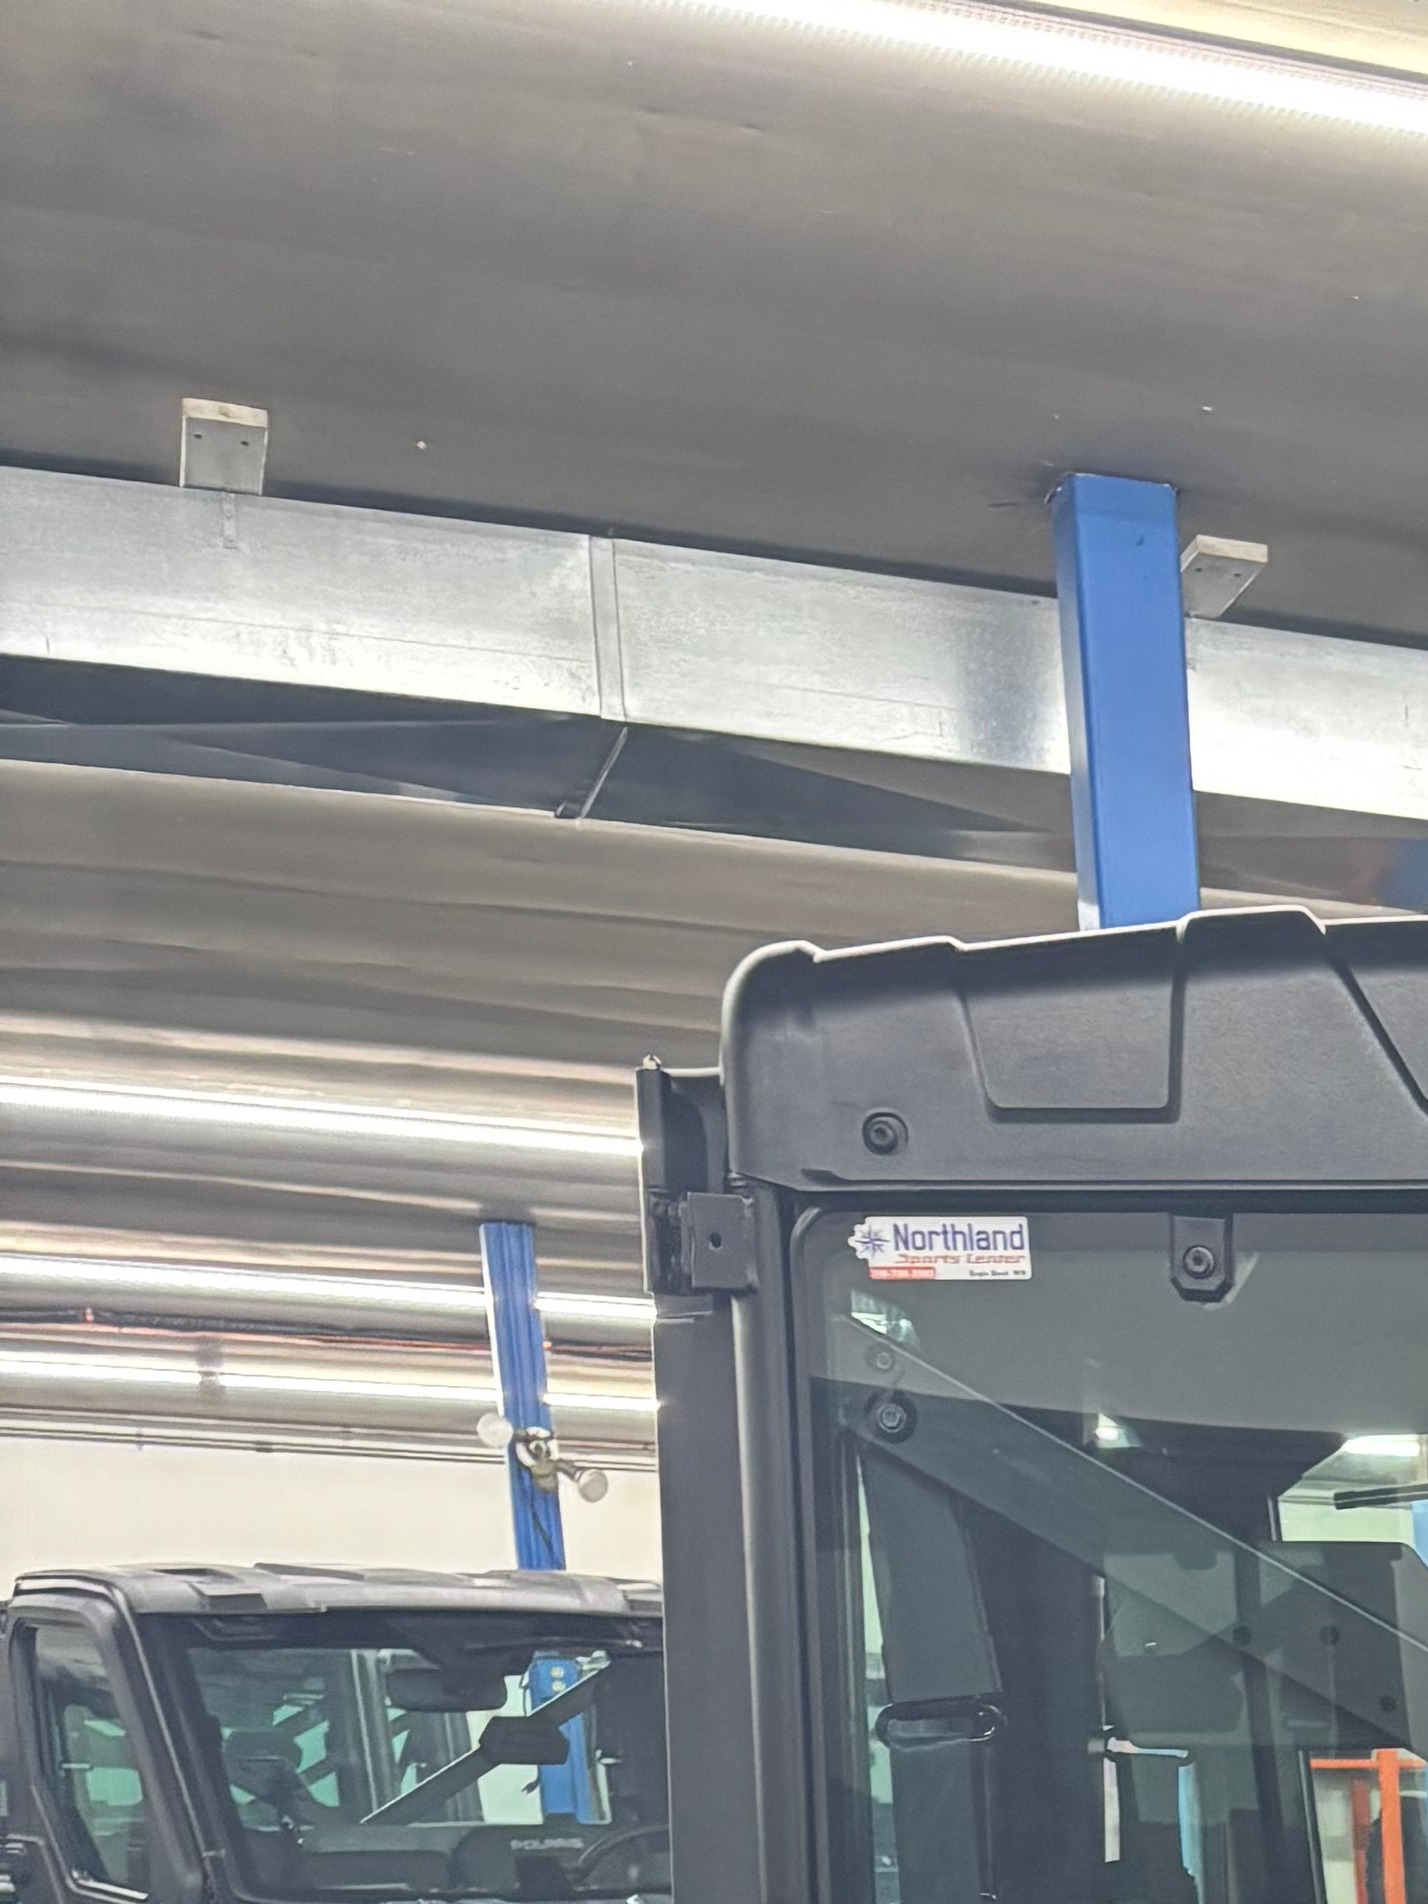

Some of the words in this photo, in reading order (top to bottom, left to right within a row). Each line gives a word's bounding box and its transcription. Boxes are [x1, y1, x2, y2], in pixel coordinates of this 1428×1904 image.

[893, 1223, 1025, 1251] Northland
[895, 1253, 960, 1264] Sports
[966, 1253, 1026, 1264] Center
